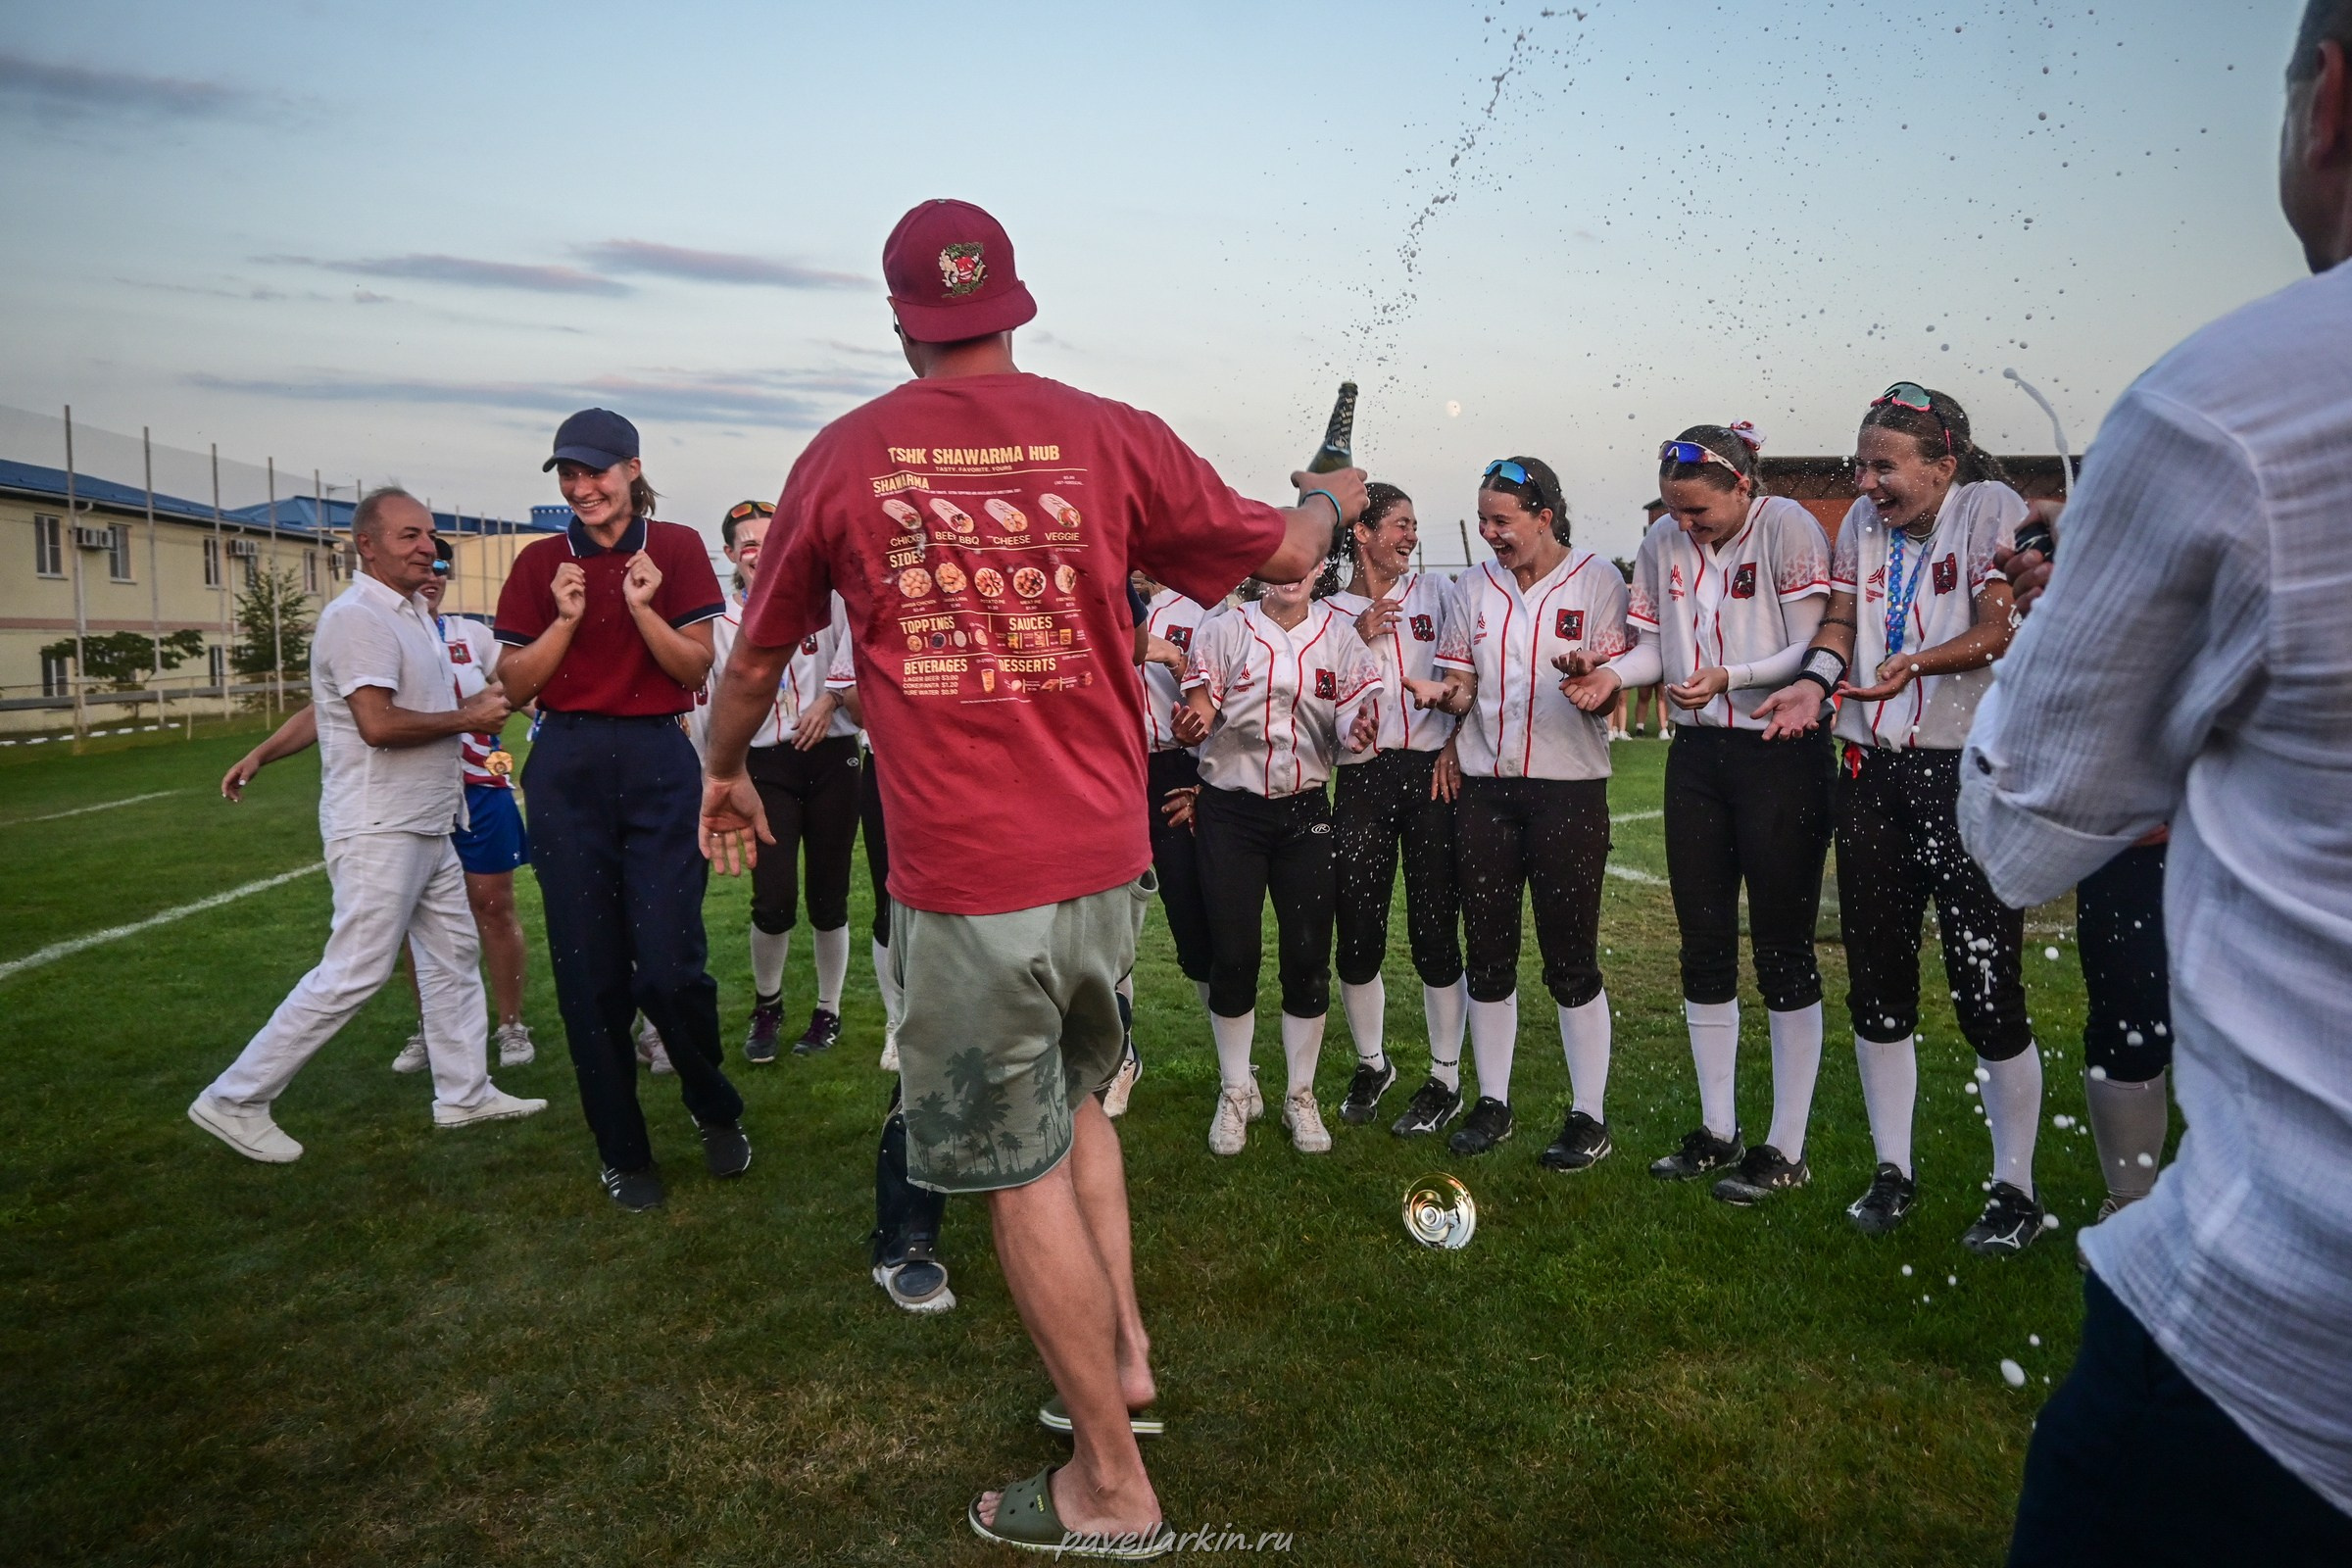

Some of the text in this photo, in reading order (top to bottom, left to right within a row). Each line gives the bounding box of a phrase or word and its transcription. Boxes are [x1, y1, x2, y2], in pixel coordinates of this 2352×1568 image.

[888, 445, 1061, 466] TSHK SHAWARMA HUB
[872, 473, 930, 494] SHAWARMA
[890, 532, 927, 548] CHICKEN
[959, 535, 980, 546] BBQ
[993, 534, 1031, 545] CHEESE
[1044, 532, 1081, 542] VEGGIE
[889, 551, 926, 568] SIDES
[900, 615, 956, 635] TOPPINGS
[1008, 615, 1054, 631] SAUCES
[904, 659, 968, 675] BEVERAGES
[998, 658, 1056, 672] DESSERTS
